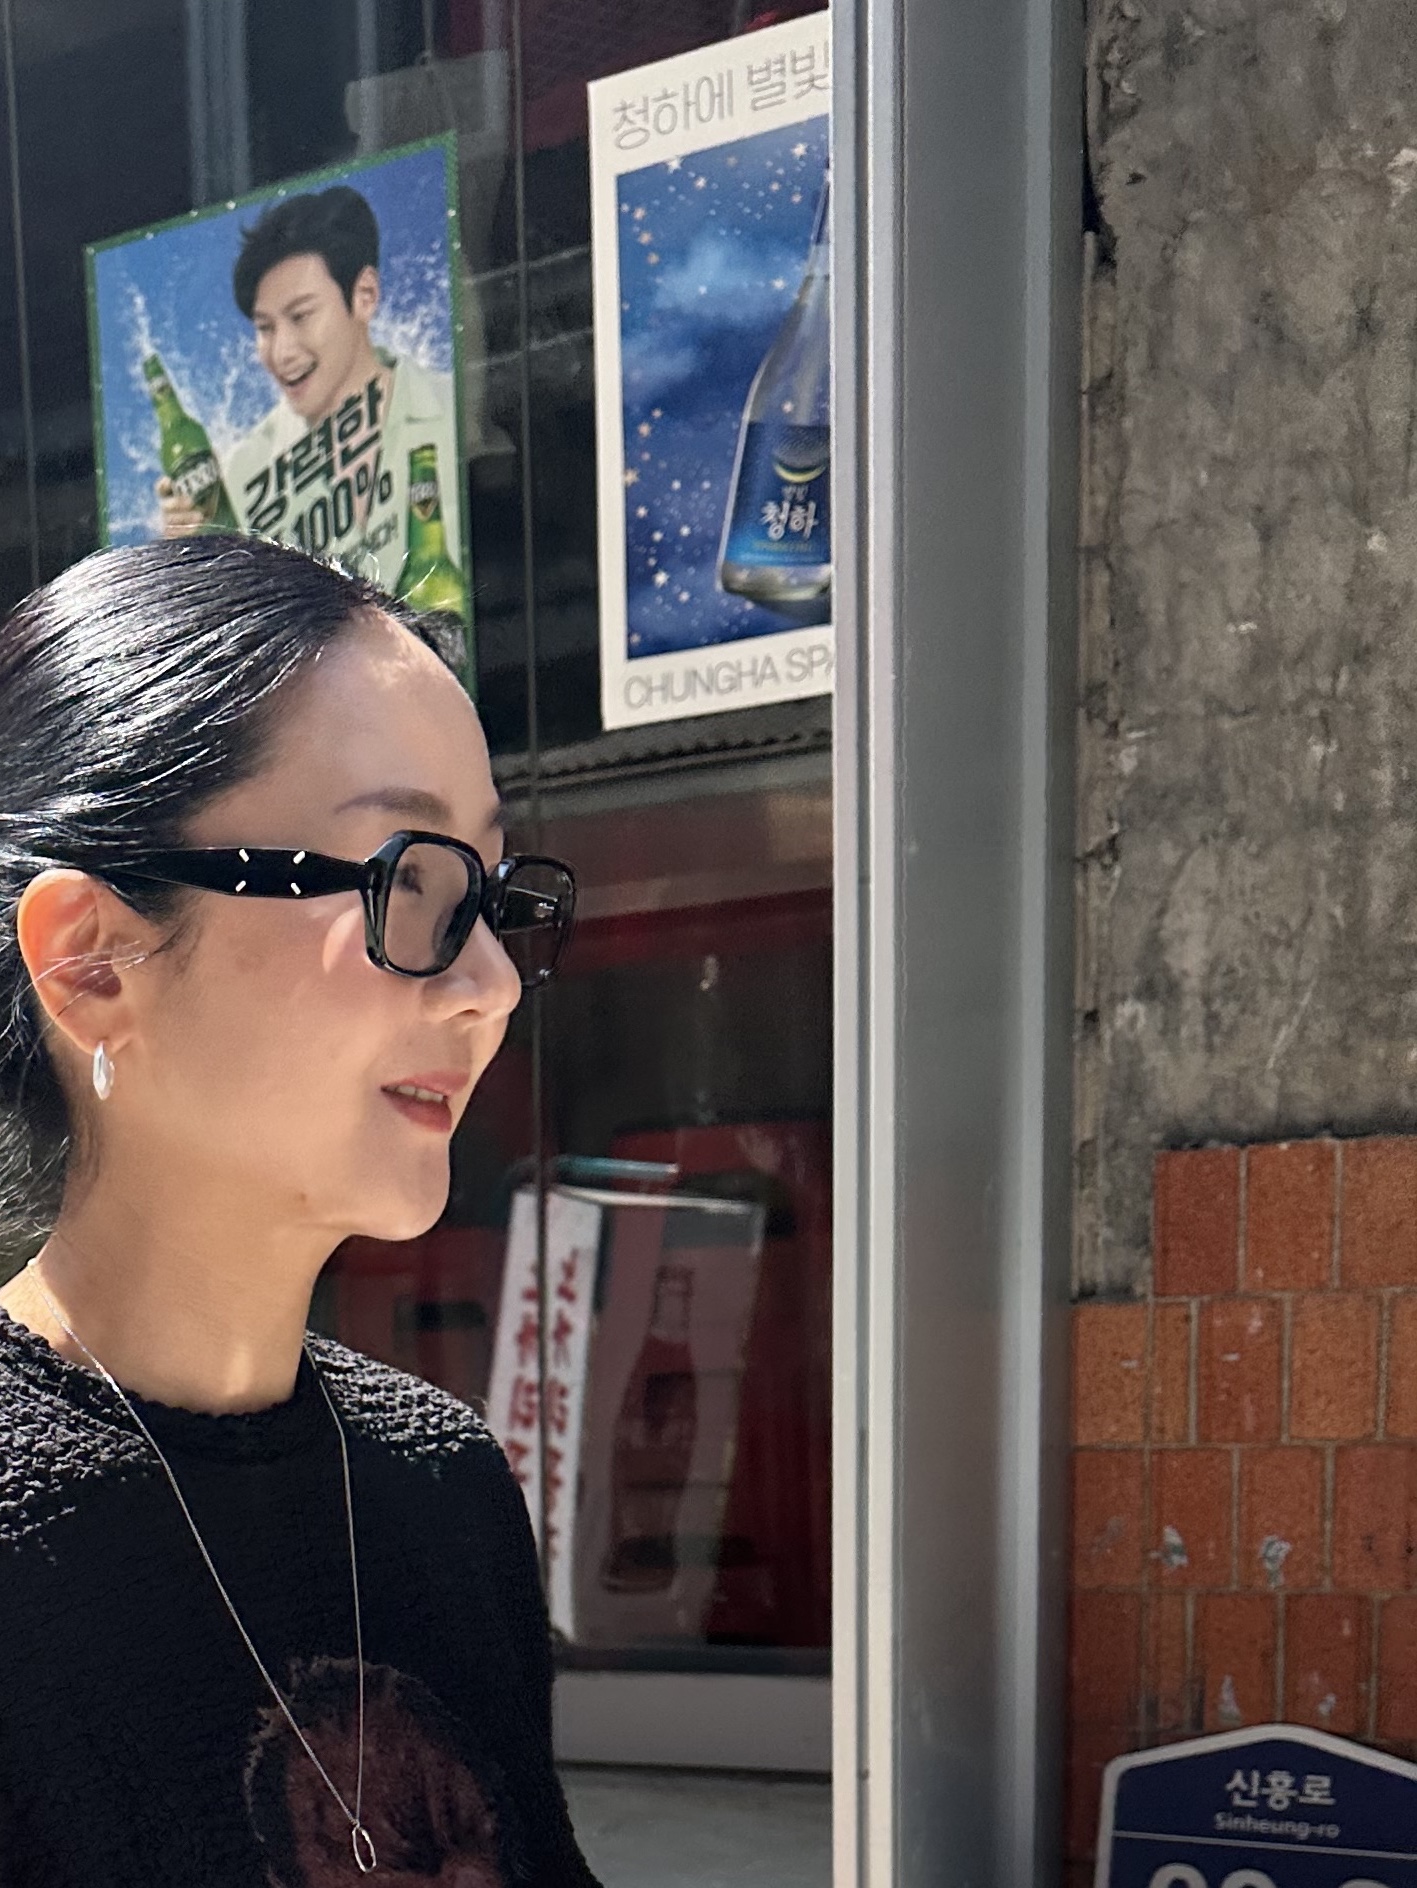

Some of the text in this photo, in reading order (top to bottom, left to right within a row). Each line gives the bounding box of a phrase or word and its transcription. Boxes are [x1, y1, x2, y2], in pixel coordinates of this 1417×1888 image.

[611, 68, 735, 151] 청하에
[244, 376, 384, 535] 강력한
[293, 448, 392, 552] 100%
[759, 501, 819, 541] 청하
[623, 653, 781, 709] CHUNGHA
[1213, 1811, 1341, 1840] Sinheung-ro
